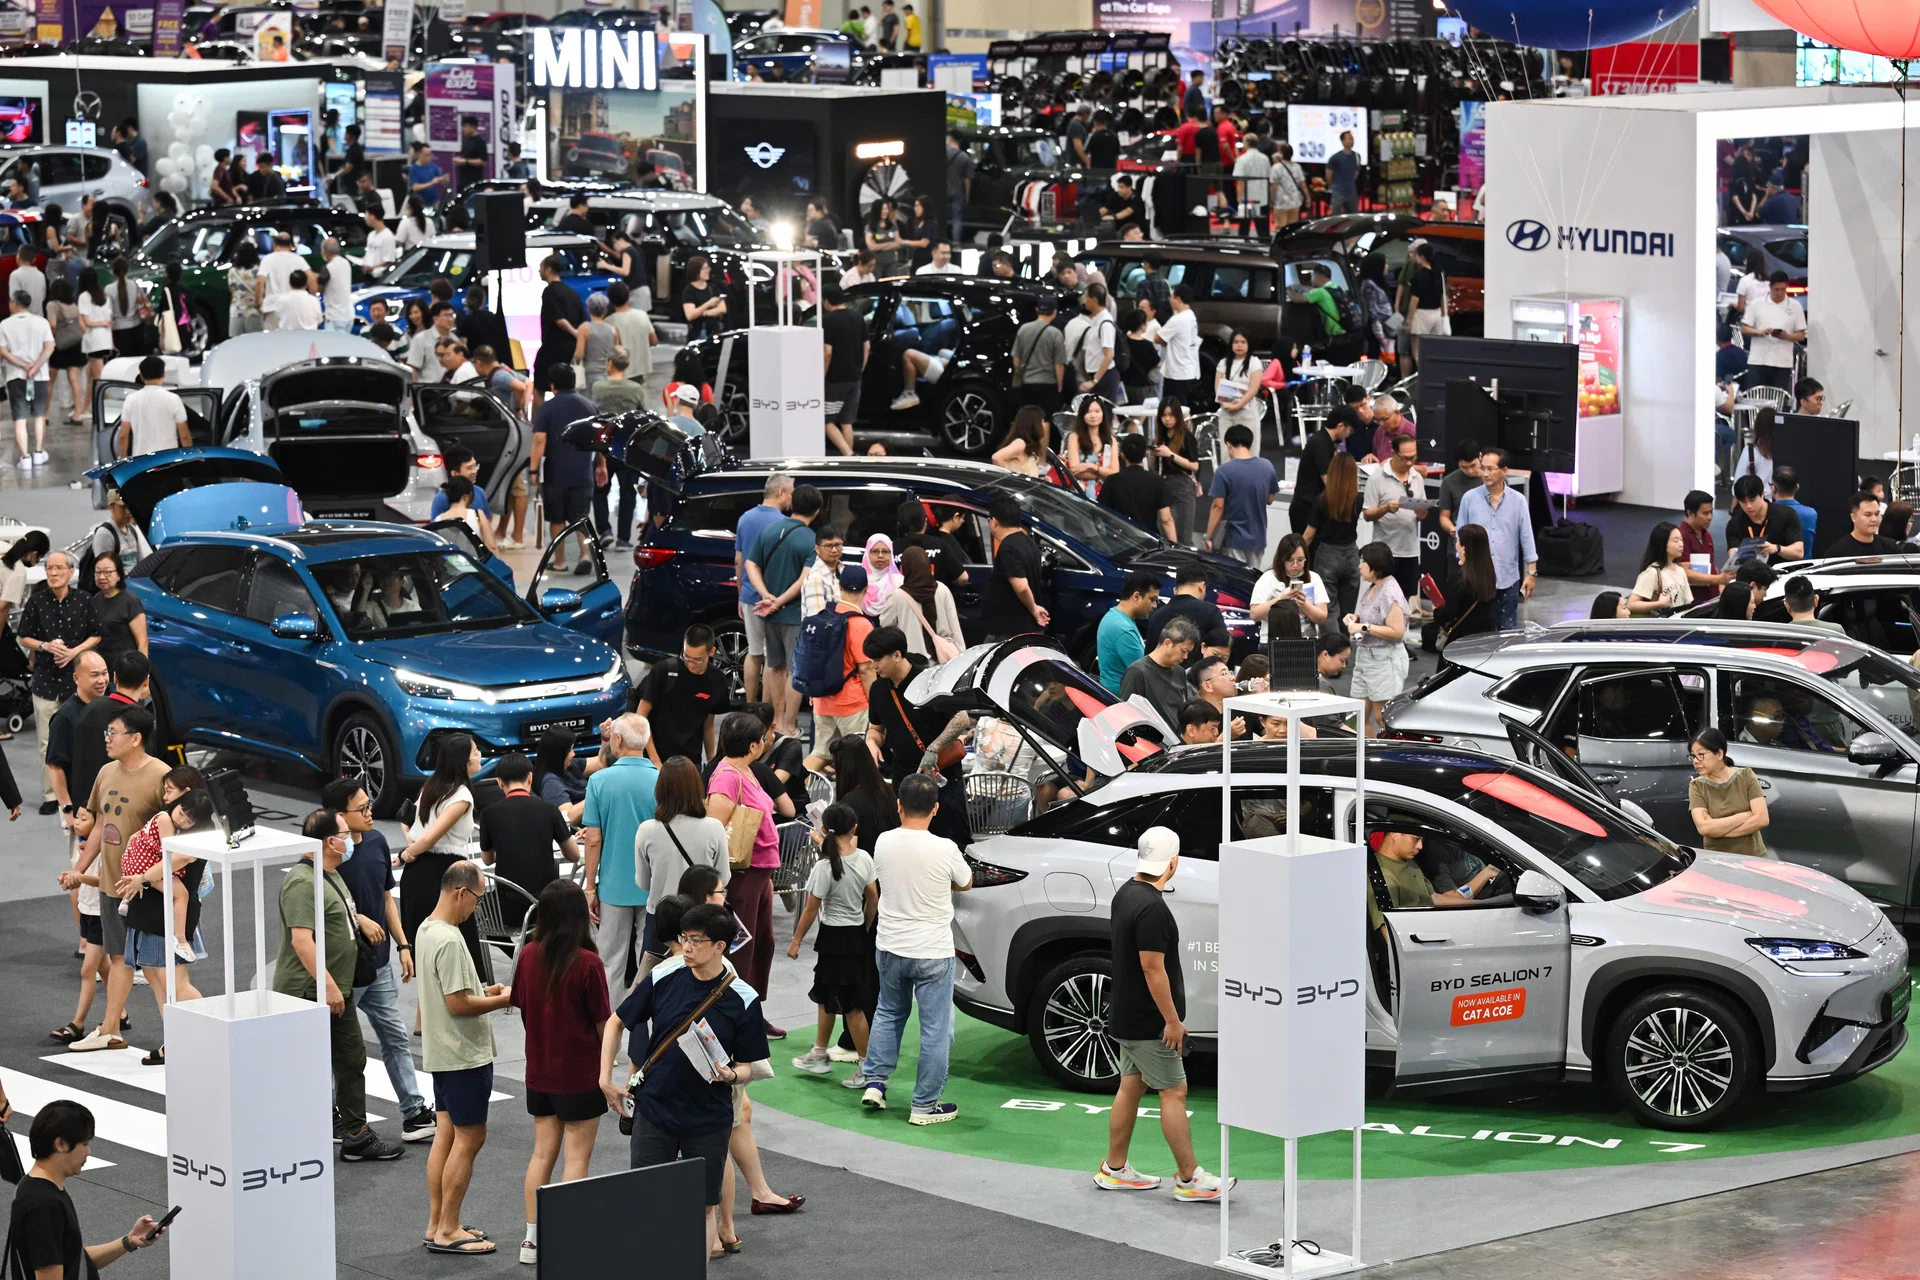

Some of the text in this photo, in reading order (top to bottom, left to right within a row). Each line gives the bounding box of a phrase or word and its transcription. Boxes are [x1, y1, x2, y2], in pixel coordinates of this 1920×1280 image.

[533, 28, 657, 90] MINI
[1557, 226, 1674, 257] HYUNDAI
[752, 398, 780, 411] BYD
[786, 399, 821, 411] BYD
[529, 723, 550, 732] BYD
[552, 720, 577, 729] TTO
[1187, 941, 1201, 952] #1
[1193, 960, 1207, 972] IN
[1430, 965, 1553, 992] BYD SEALION 7
[1224, 978, 1283, 1006] BYD
[1297, 979, 1360, 1005] BYD
[1458, 992, 1521, 1008] NOW AVAILABLE IN
[1462, 1004, 1513, 1021] CAT A COE
[1649, 1141, 1706, 1153] 7
[172, 1153, 226, 1188] BYD
[243, 1159, 325, 1191] BYD
